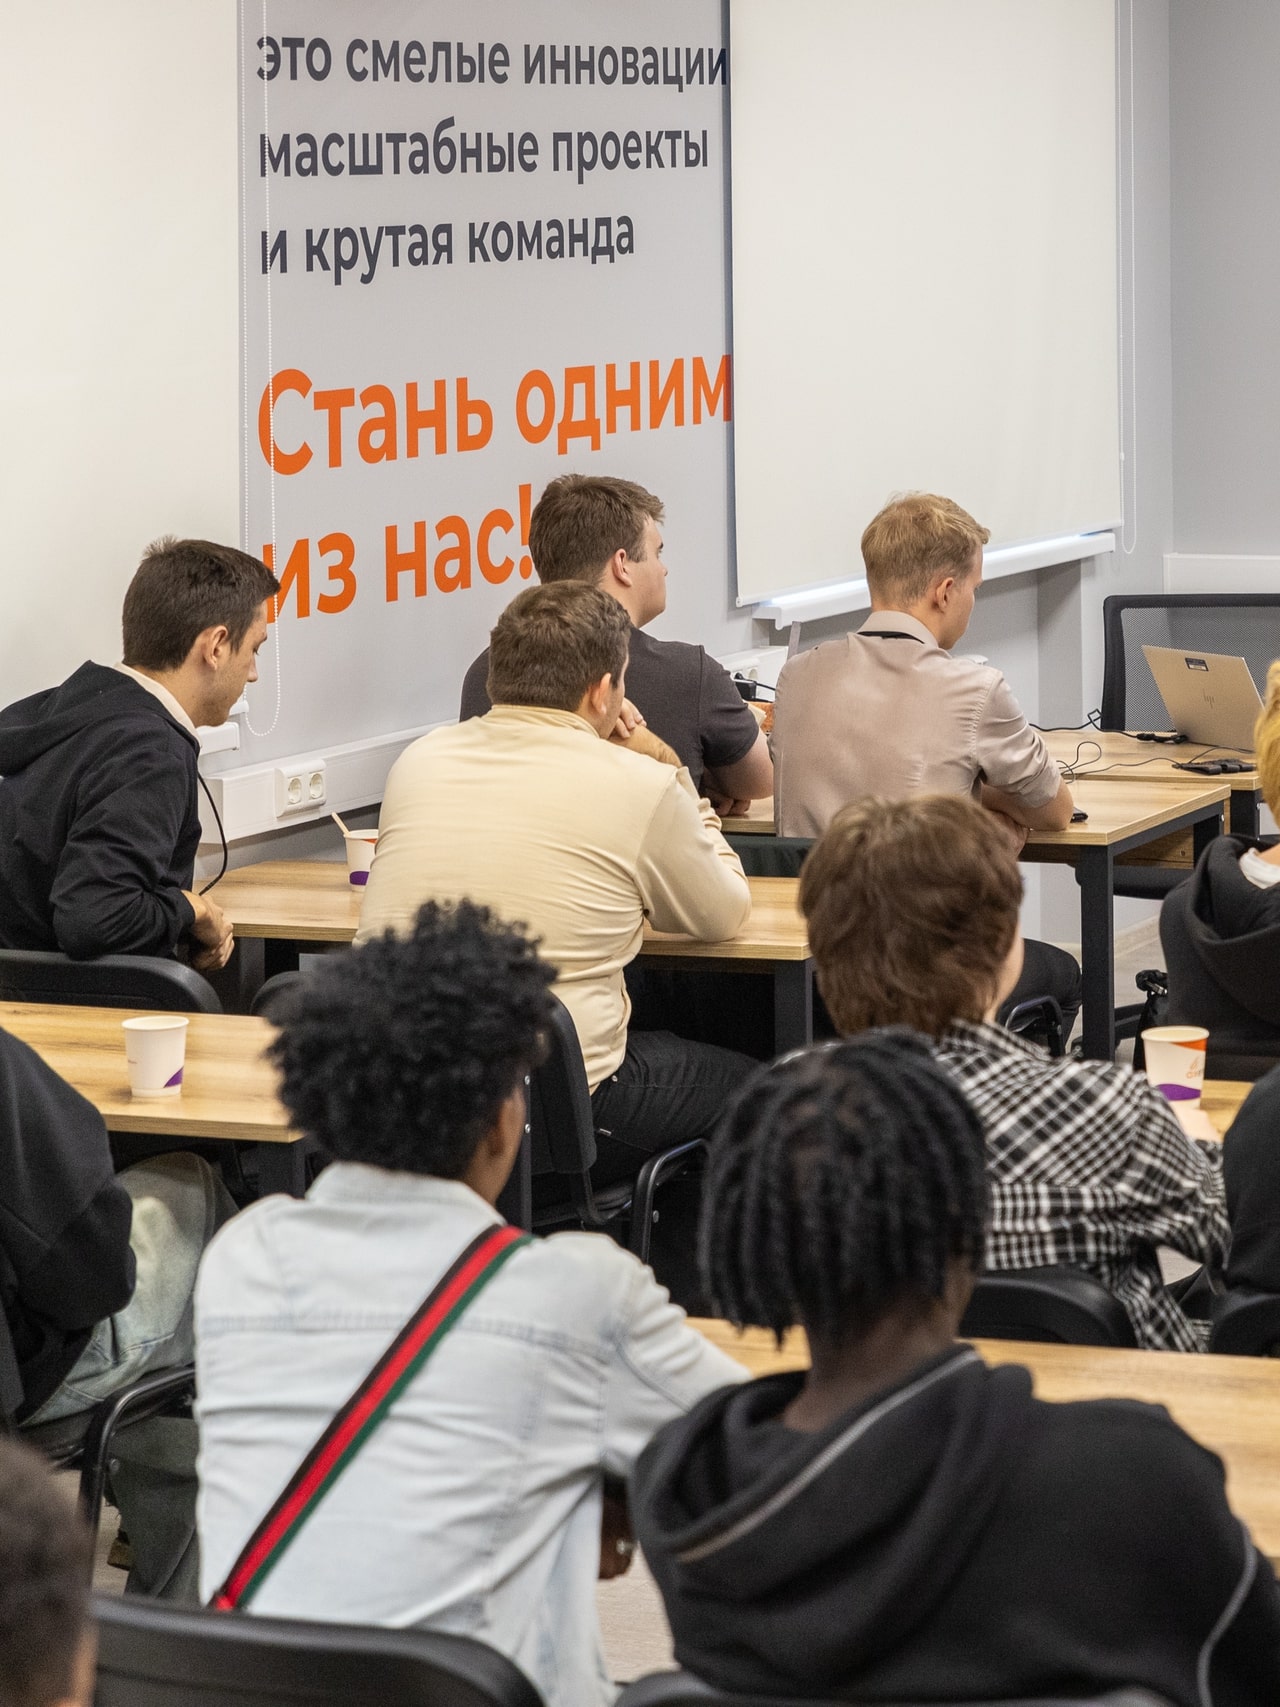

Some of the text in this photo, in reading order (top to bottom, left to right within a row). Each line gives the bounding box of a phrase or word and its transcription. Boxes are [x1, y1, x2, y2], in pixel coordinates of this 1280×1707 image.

[257, 36, 727, 92] это смелые инновации
[260, 115, 708, 185] масштабные проекты
[261, 213, 635, 286] и крутая команда
[258, 354, 733, 476] Стань одним
[262, 483, 533, 625] из нас!
